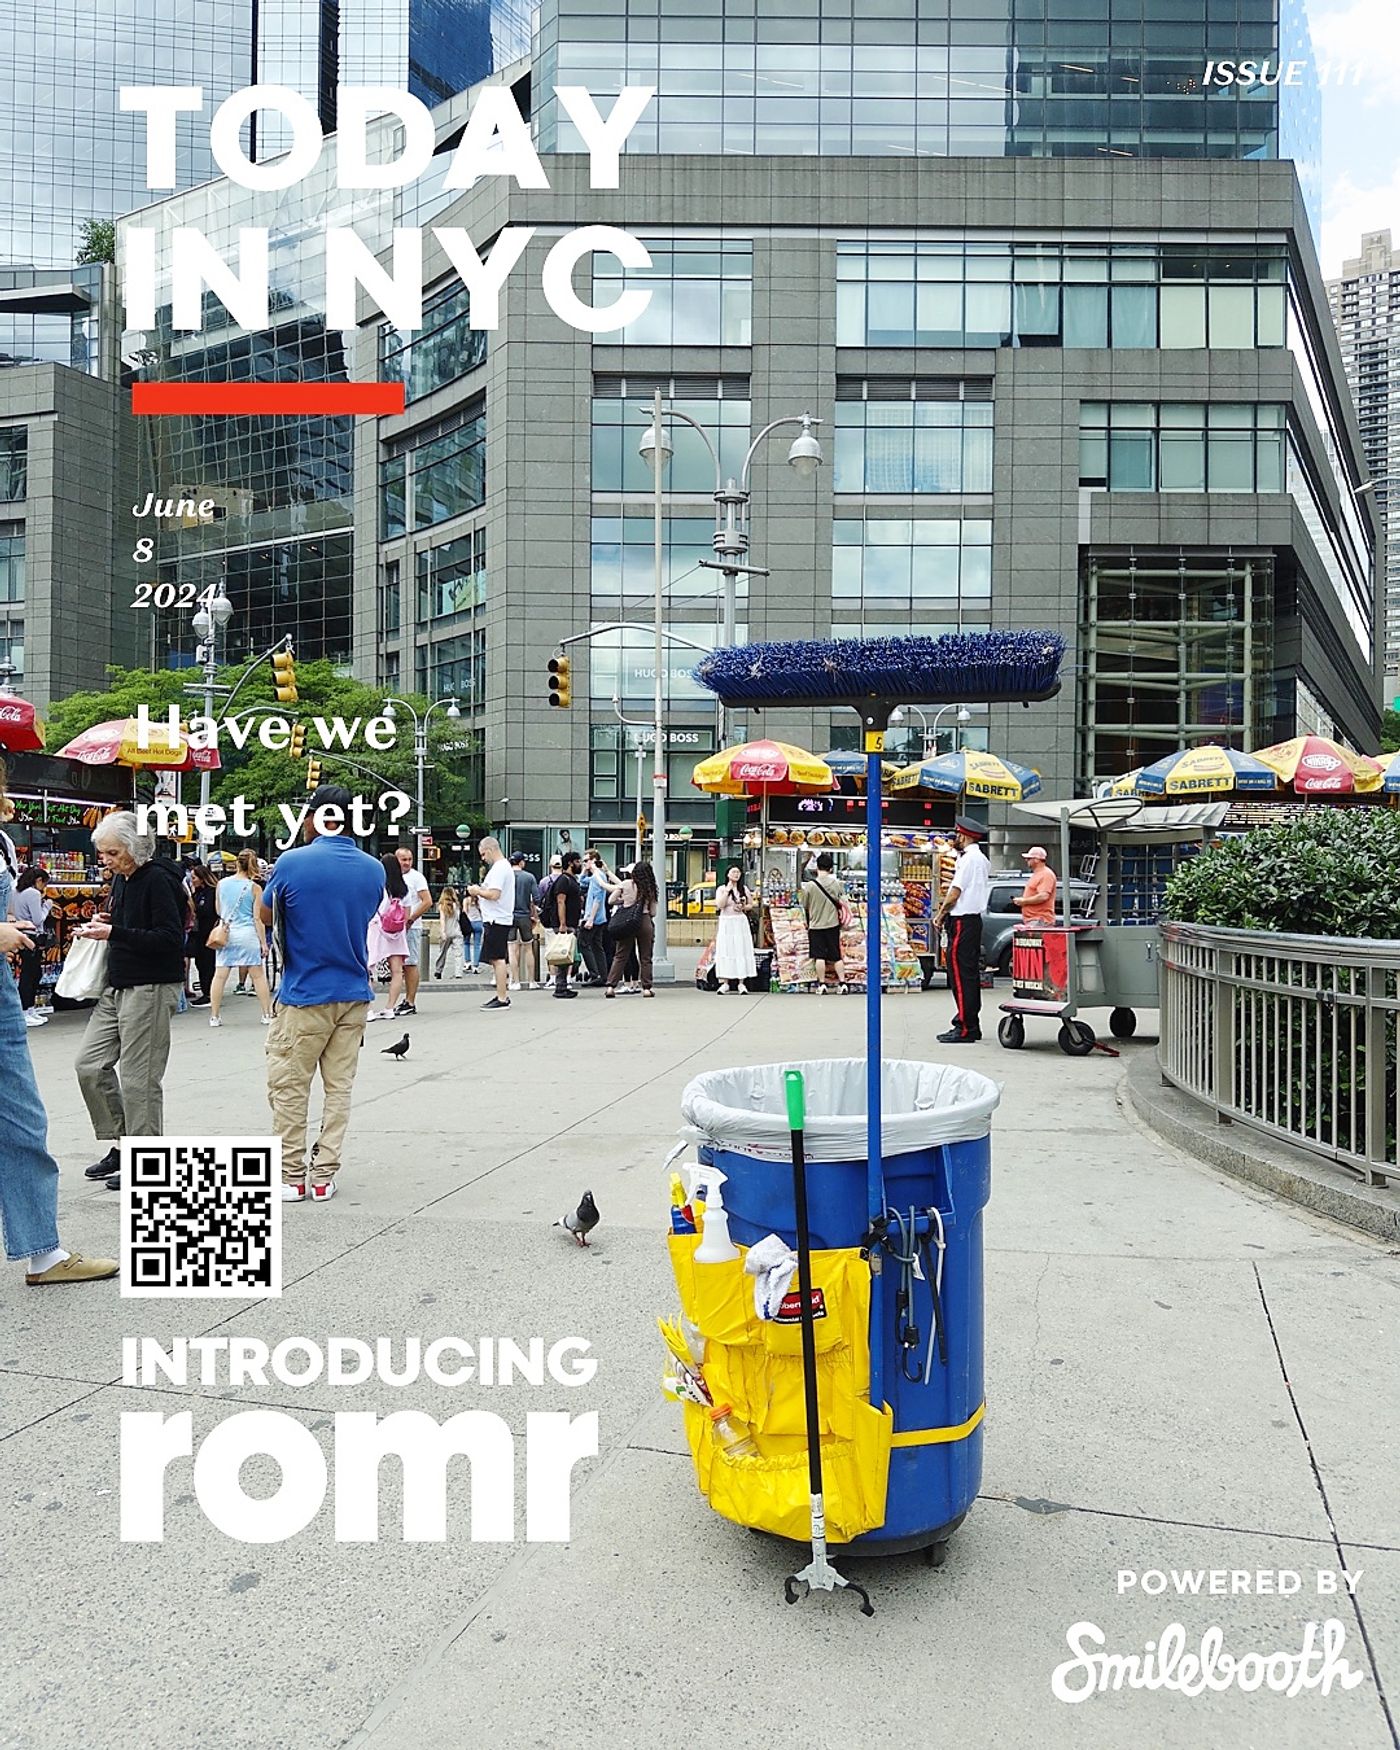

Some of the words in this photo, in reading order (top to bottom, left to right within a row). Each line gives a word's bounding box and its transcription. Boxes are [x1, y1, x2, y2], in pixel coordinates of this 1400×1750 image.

[670, 668, 694, 679] BOS
[669, 732, 699, 743] BOSS
[875, 736, 882, 750] 5
[740, 763, 776, 777] Coca-Cola
[968, 781, 1019, 798] SABRETT
[1170, 776, 1230, 791] SABRETT
[1305, 777, 1341, 790] Coca-Cola
